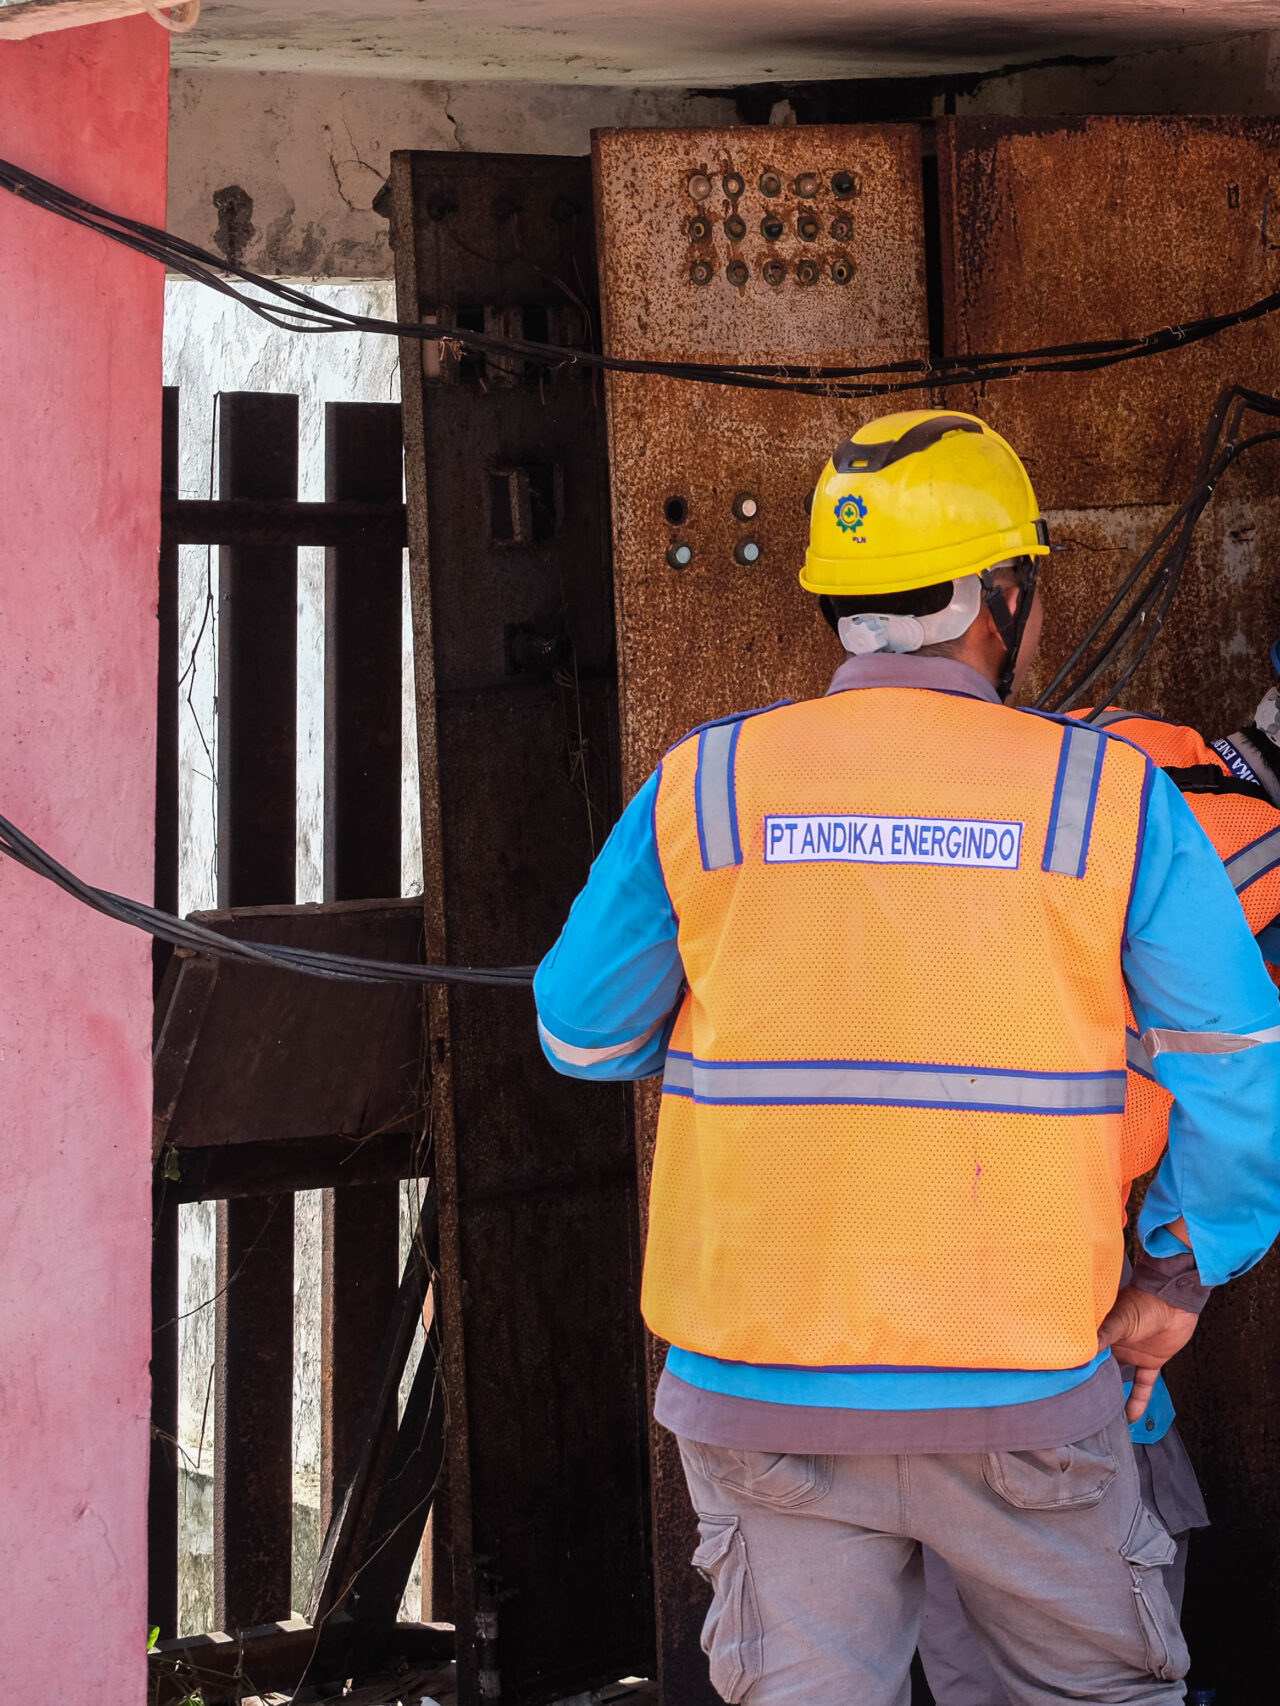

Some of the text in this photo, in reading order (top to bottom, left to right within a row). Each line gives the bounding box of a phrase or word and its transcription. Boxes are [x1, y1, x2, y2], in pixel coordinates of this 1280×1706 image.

[770, 822, 1016, 861] PT ANDIKA ENERGINDO
